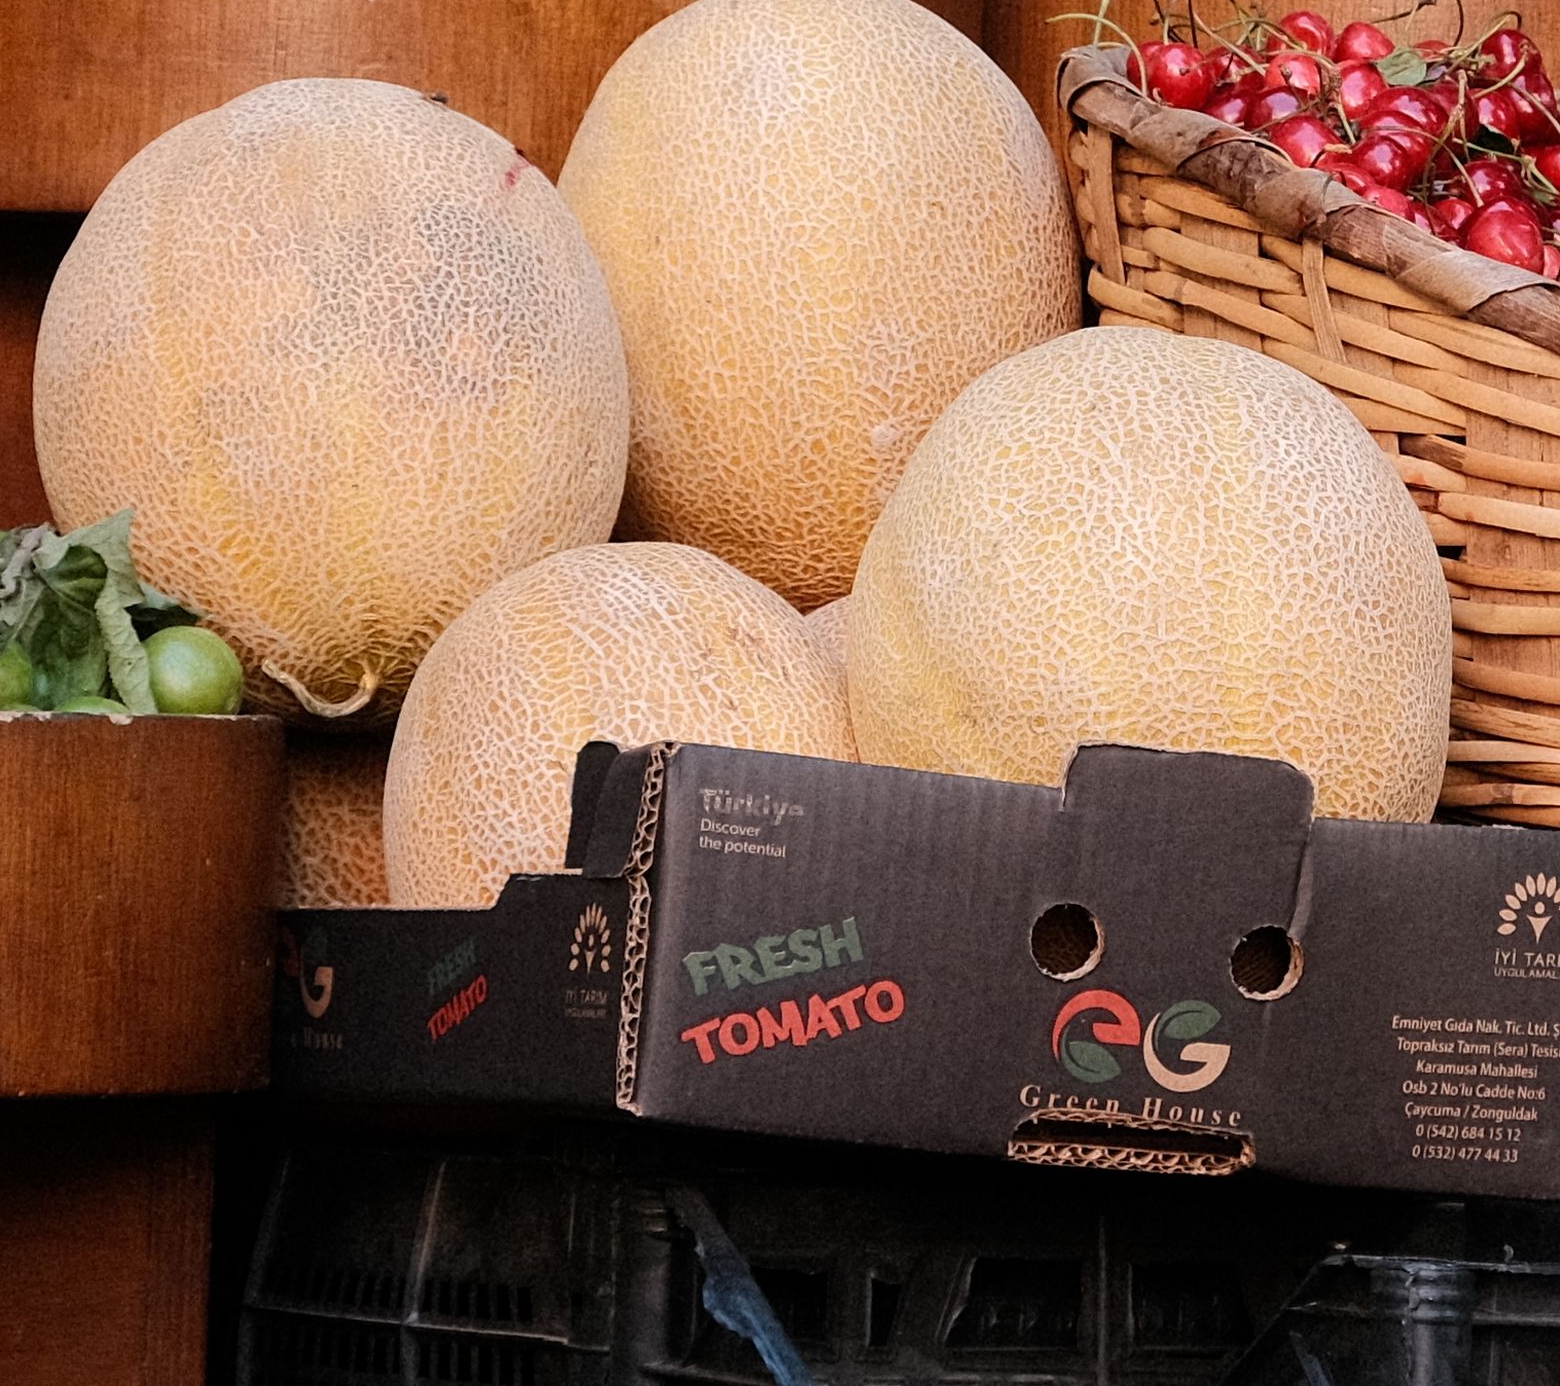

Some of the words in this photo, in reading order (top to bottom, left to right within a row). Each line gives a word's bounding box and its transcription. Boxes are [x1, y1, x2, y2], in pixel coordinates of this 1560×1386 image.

[700, 818, 761, 838] Discover
[699, 836, 721, 851] the
[724, 839, 786, 858] potential
[682, 916, 864, 997] FRESH
[1493, 947, 1517, 966] İYİ
[426, 974, 489, 1043] TOMATO
[681, 980, 905, 1065] TOMATO
[1392, 1015, 1442, 1033] Emniyet
[1445, 1018, 1473, 1032] Gıda
[1505, 1020, 1525, 1035] Tic.
[1527, 1022, 1550, 1037] Ltd.
[1397, 1037, 1454, 1054] Topraksız
[1457, 1040, 1490, 1055] Tarım
[1493, 1041, 1528, 1058] (Sera)
[1416, 1059, 1477, 1075] Karamusa
[1480, 1062, 1538, 1079] Mahallesi
[1402, 1080, 1427, 1094] Osb
[1429, 1082, 1438, 1095] 2
[1475, 1084, 1515, 1099] Cadde
[1517, 1086, 1546, 1101] No:6
[1019, 1084, 1121, 1115] Green
[1142, 1097, 1242, 1128] House
[1404, 1101, 1461, 1119] Çaycuma
[1462, 1104, 1471, 1119] /
[1471, 1104, 1539, 1123] Zonguldak
[1415, 1123, 1424, 1137] 0
[1426, 1124, 1459, 1140] (542)
[1461, 1126, 1485, 1140] 684
[1489, 1127, 1503, 1141] 15
[1506, 1128, 1521, 1142] 12
[1412, 1144, 1421, 1158] 0
[1423, 1145, 1456, 1160] (532)
[1458, 1147, 1482, 1161] 477
[1484, 1148, 1500, 1162] 44
[1502, 1149, 1518, 1163] 33
